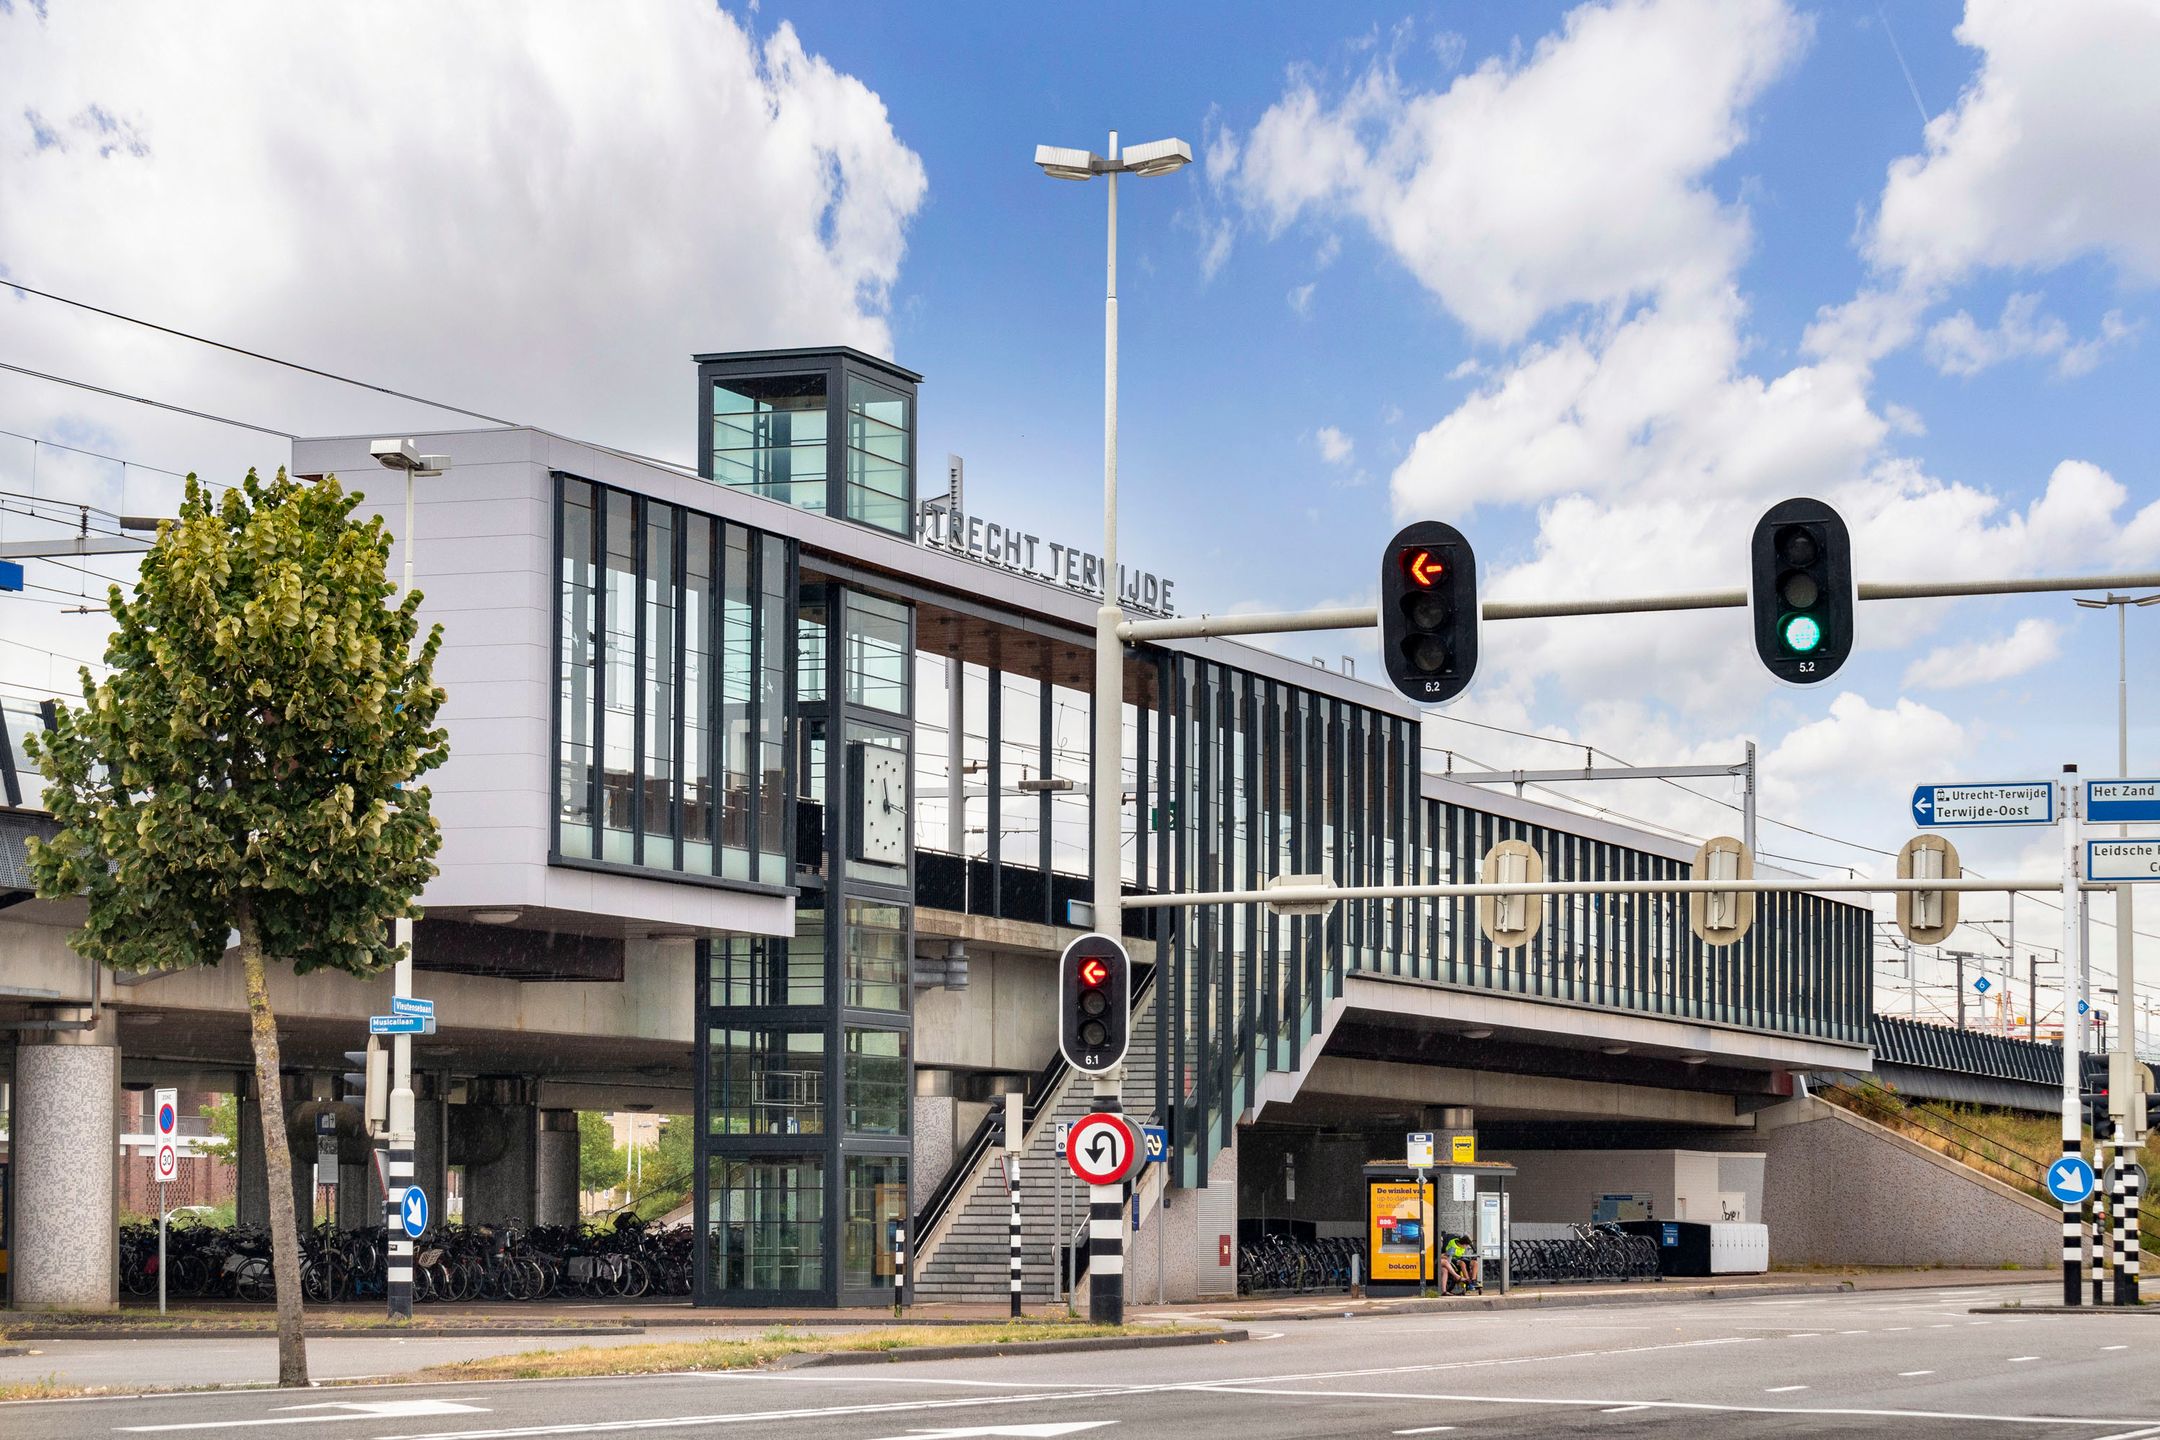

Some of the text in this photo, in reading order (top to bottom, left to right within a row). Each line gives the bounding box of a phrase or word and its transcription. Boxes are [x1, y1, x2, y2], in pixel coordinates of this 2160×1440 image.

[1799, 661, 1815, 673] 5.2
[1425, 681, 1440, 692] 6.2
[1952, 788, 2047, 801] Utrecht-Terwijde
[2094, 785, 2155, 797] Het Zand
[1936, 805, 2029, 819] Terwijde-Oost
[2094, 845, 2152, 856] Leidsche
[2150, 861, 2160, 873] C
[1979, 980, 1985, 989] 6
[2079, 1003, 2085, 1011] 8
[1085, 1054, 1099, 1065] 6.1
[162, 1154, 171, 1167] 30
